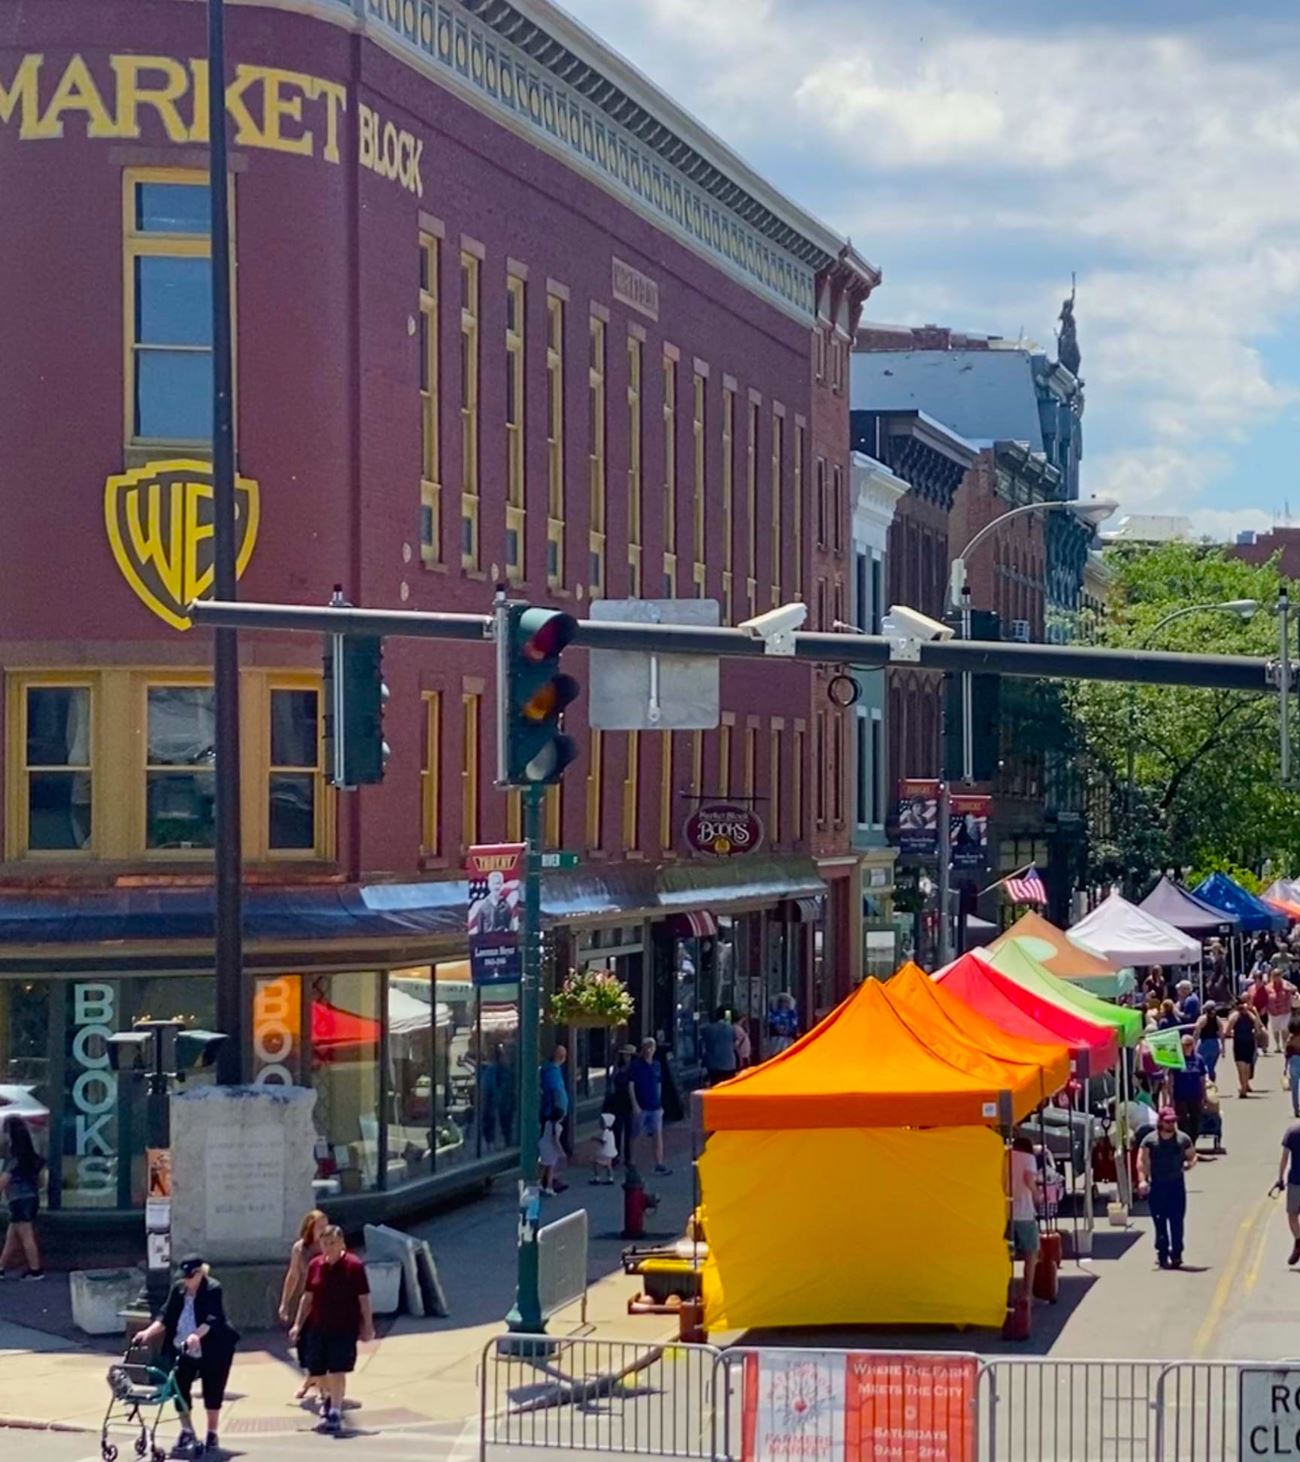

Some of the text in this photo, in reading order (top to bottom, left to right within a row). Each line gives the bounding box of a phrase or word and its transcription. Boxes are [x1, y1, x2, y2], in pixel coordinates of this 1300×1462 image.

[0, 53, 424, 198] MARKET BLOCK
[541, 853, 560, 868] RIVER
[72, 983, 119, 1198] BOOKS
[854, 1363, 970, 1379] WHERE THE FARM
[858, 1383, 964, 1397] MEETS THE CITY
[874, 1428, 948, 1441] SATURDAYS
